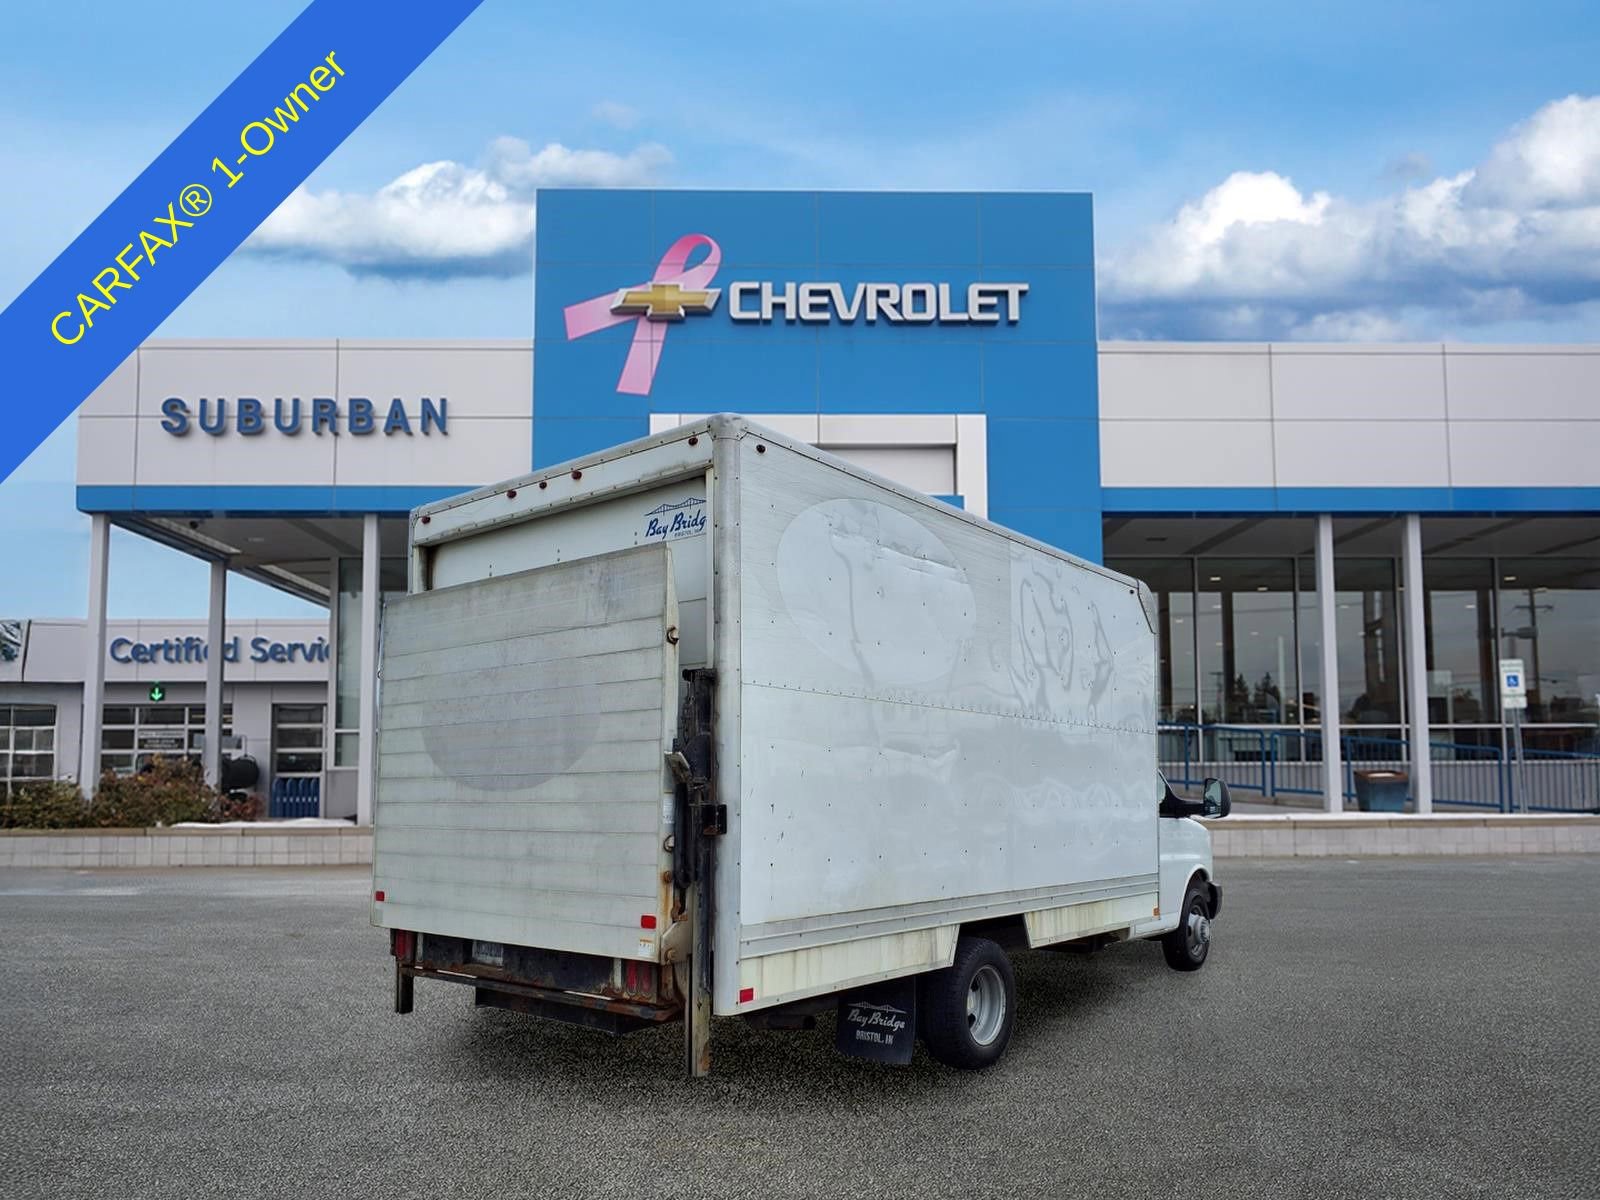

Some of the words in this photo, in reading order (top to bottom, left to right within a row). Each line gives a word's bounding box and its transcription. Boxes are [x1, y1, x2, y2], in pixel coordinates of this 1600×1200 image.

[729, 281, 1030, 322] CHEVROLET
[161, 397, 449, 437] SUBURBAN
[645, 517, 669, 540] Bay
[669, 509, 707, 532] Bridg
[109, 636, 241, 664] Certifid
[250, 636, 330, 664] Servi
[847, 1008, 869, 1027] Bay
[868, 1011, 906, 1032] Bridge
